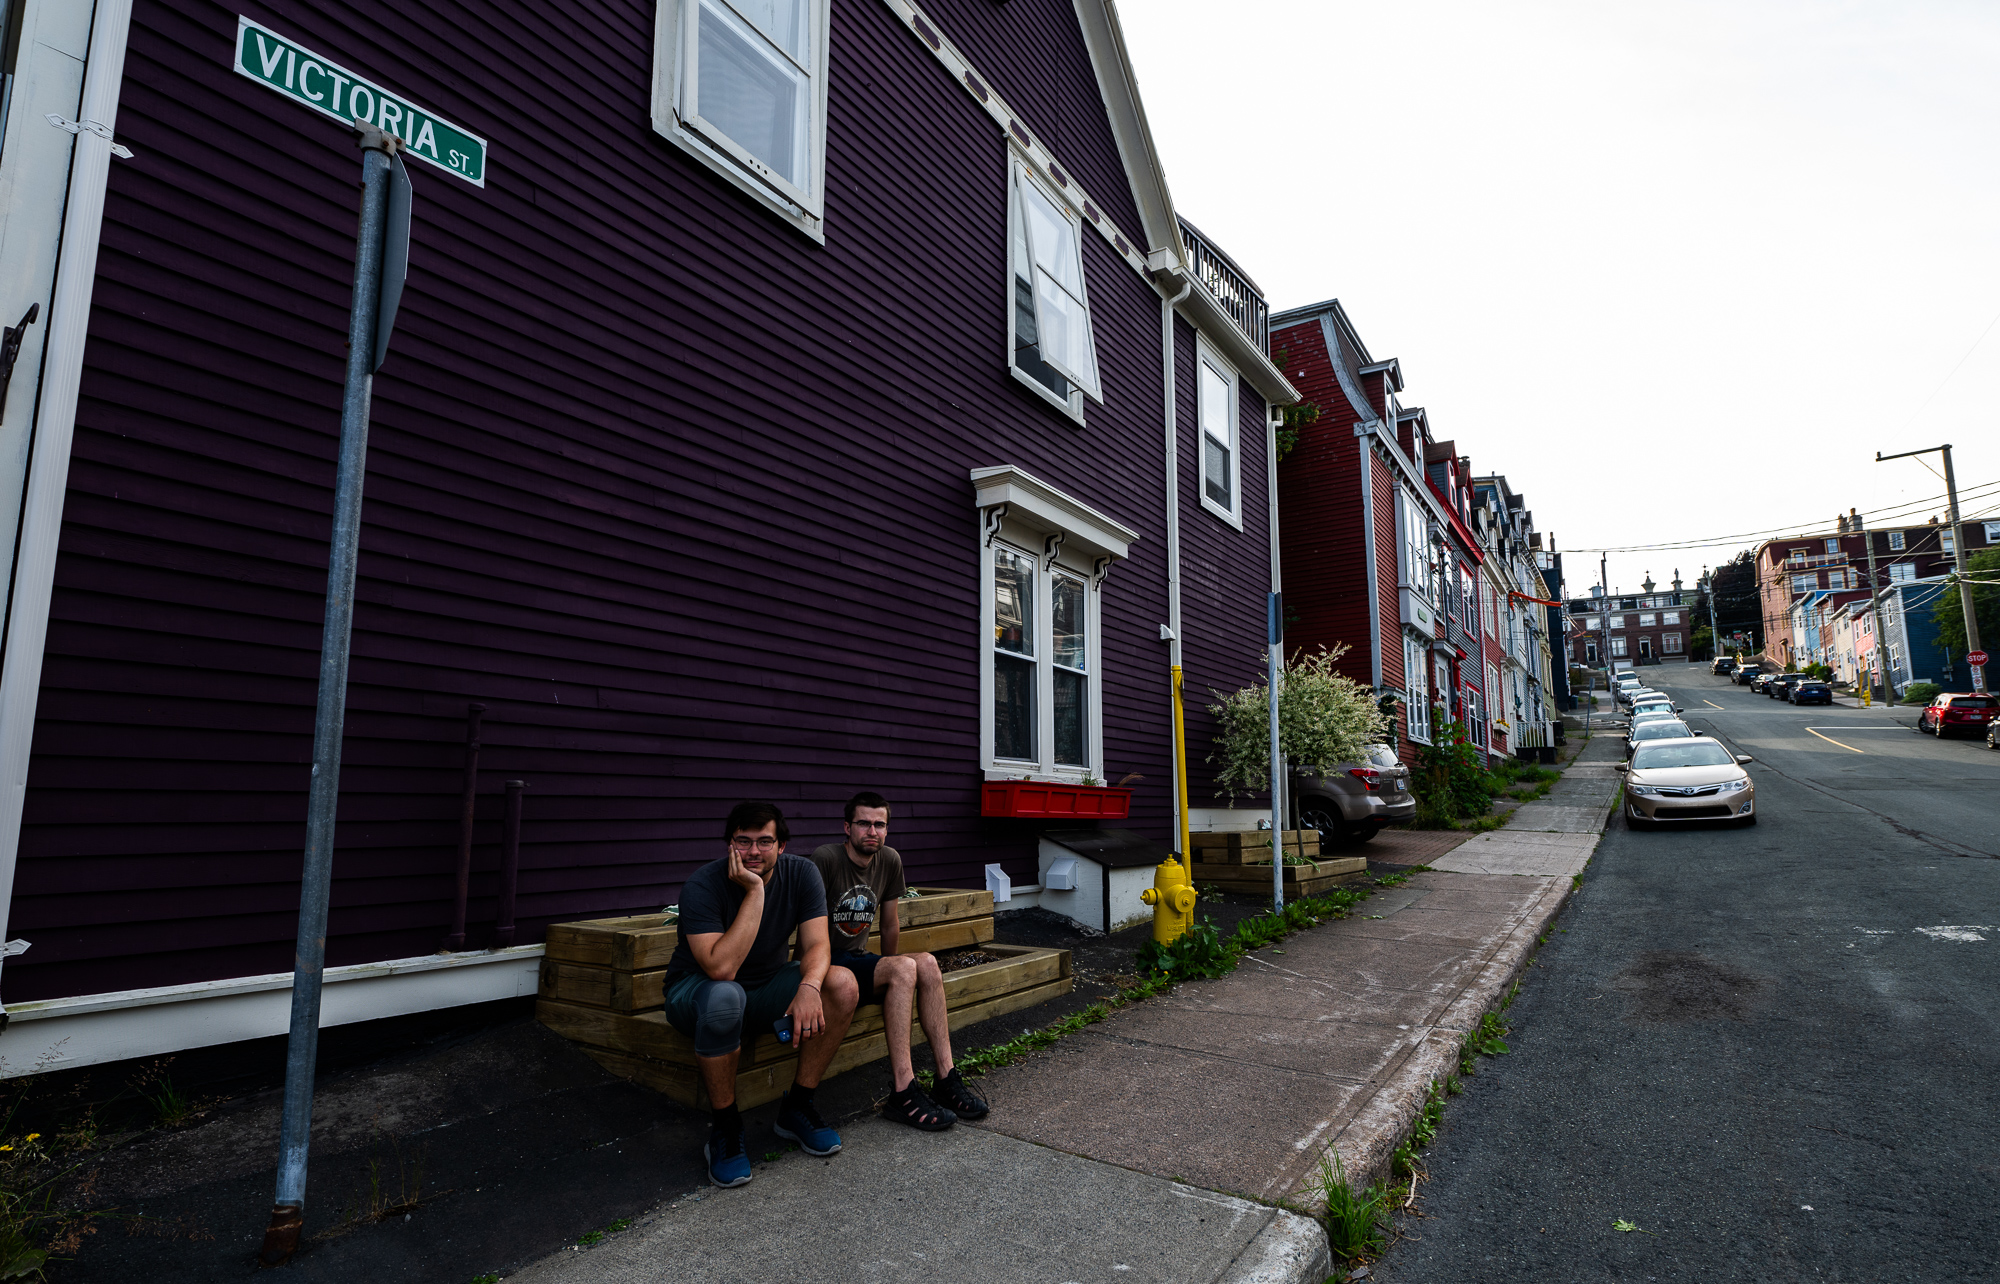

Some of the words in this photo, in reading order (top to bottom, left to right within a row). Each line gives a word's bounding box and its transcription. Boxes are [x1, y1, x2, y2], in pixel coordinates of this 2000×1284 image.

[256, 33, 438, 159] VICTORIA
[448, 149, 475, 176] ST.
[833, 911, 852, 922] ROCKY
